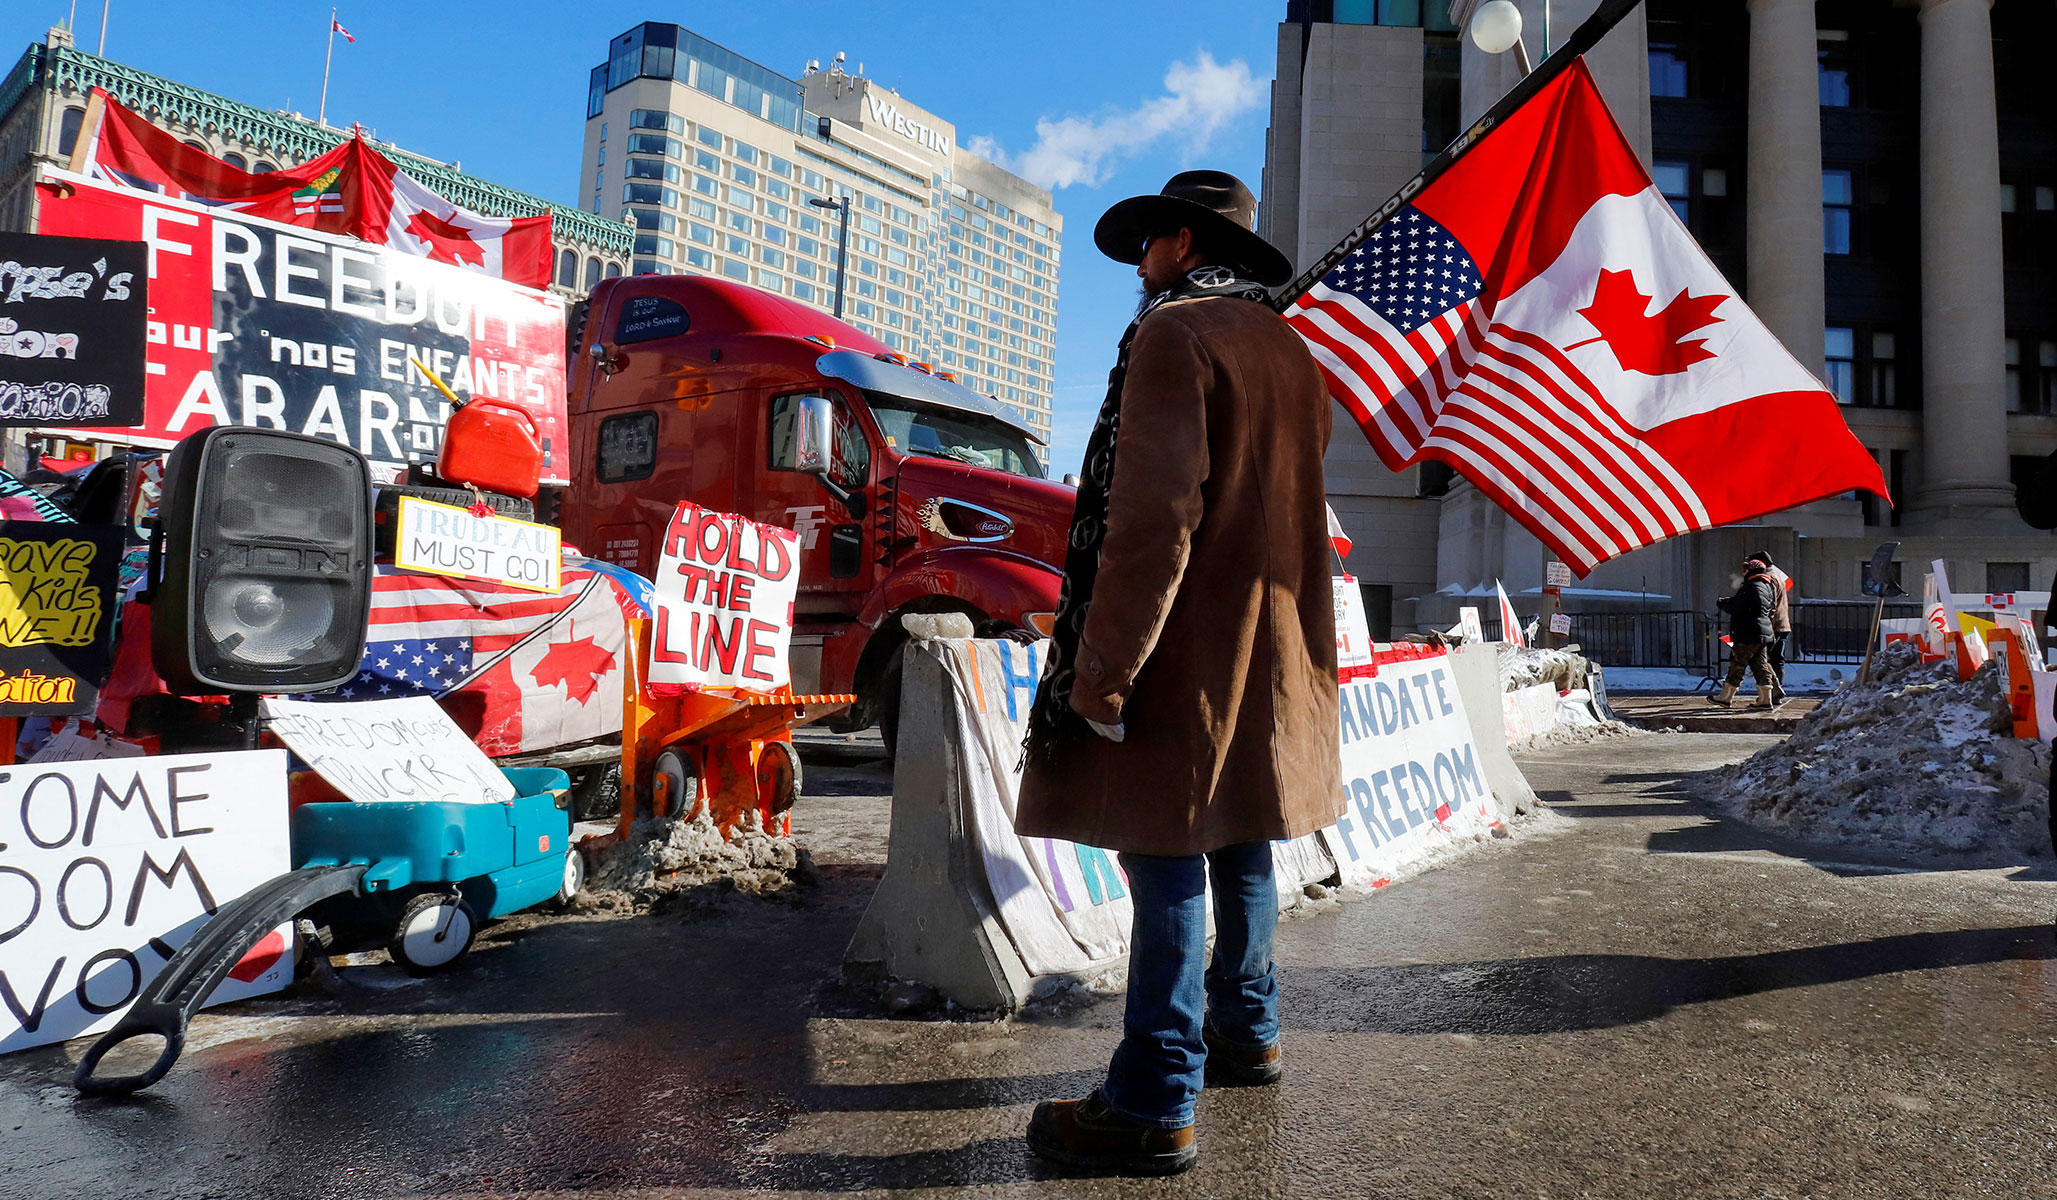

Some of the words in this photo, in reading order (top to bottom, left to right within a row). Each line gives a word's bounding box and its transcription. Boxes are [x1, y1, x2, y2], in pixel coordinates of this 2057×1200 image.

[867, 93, 950, 156] WESTIN
[0, 257, 134, 304] pse's
[633, 298, 659, 308] JESUS
[625, 321, 646, 333] LORD
[652, 315, 681, 327] Saviour
[642, 307, 657, 315] our
[380, 337, 546, 406] ENFANTS
[0, 380, 111, 421] ation
[413, 506, 549, 554] TRUDEAU
[664, 504, 793, 582] HOLD
[413, 537, 496, 574] MUST
[506, 555, 550, 589] GO!
[677, 563, 755, 612] THE
[18, 575, 97, 613] Kids
[654, 605, 780, 682] LINE
[1339, 668, 1454, 745] ANDATE
[0, 763, 214, 850] OME
[1336, 743, 1484, 863] FREEDOM
